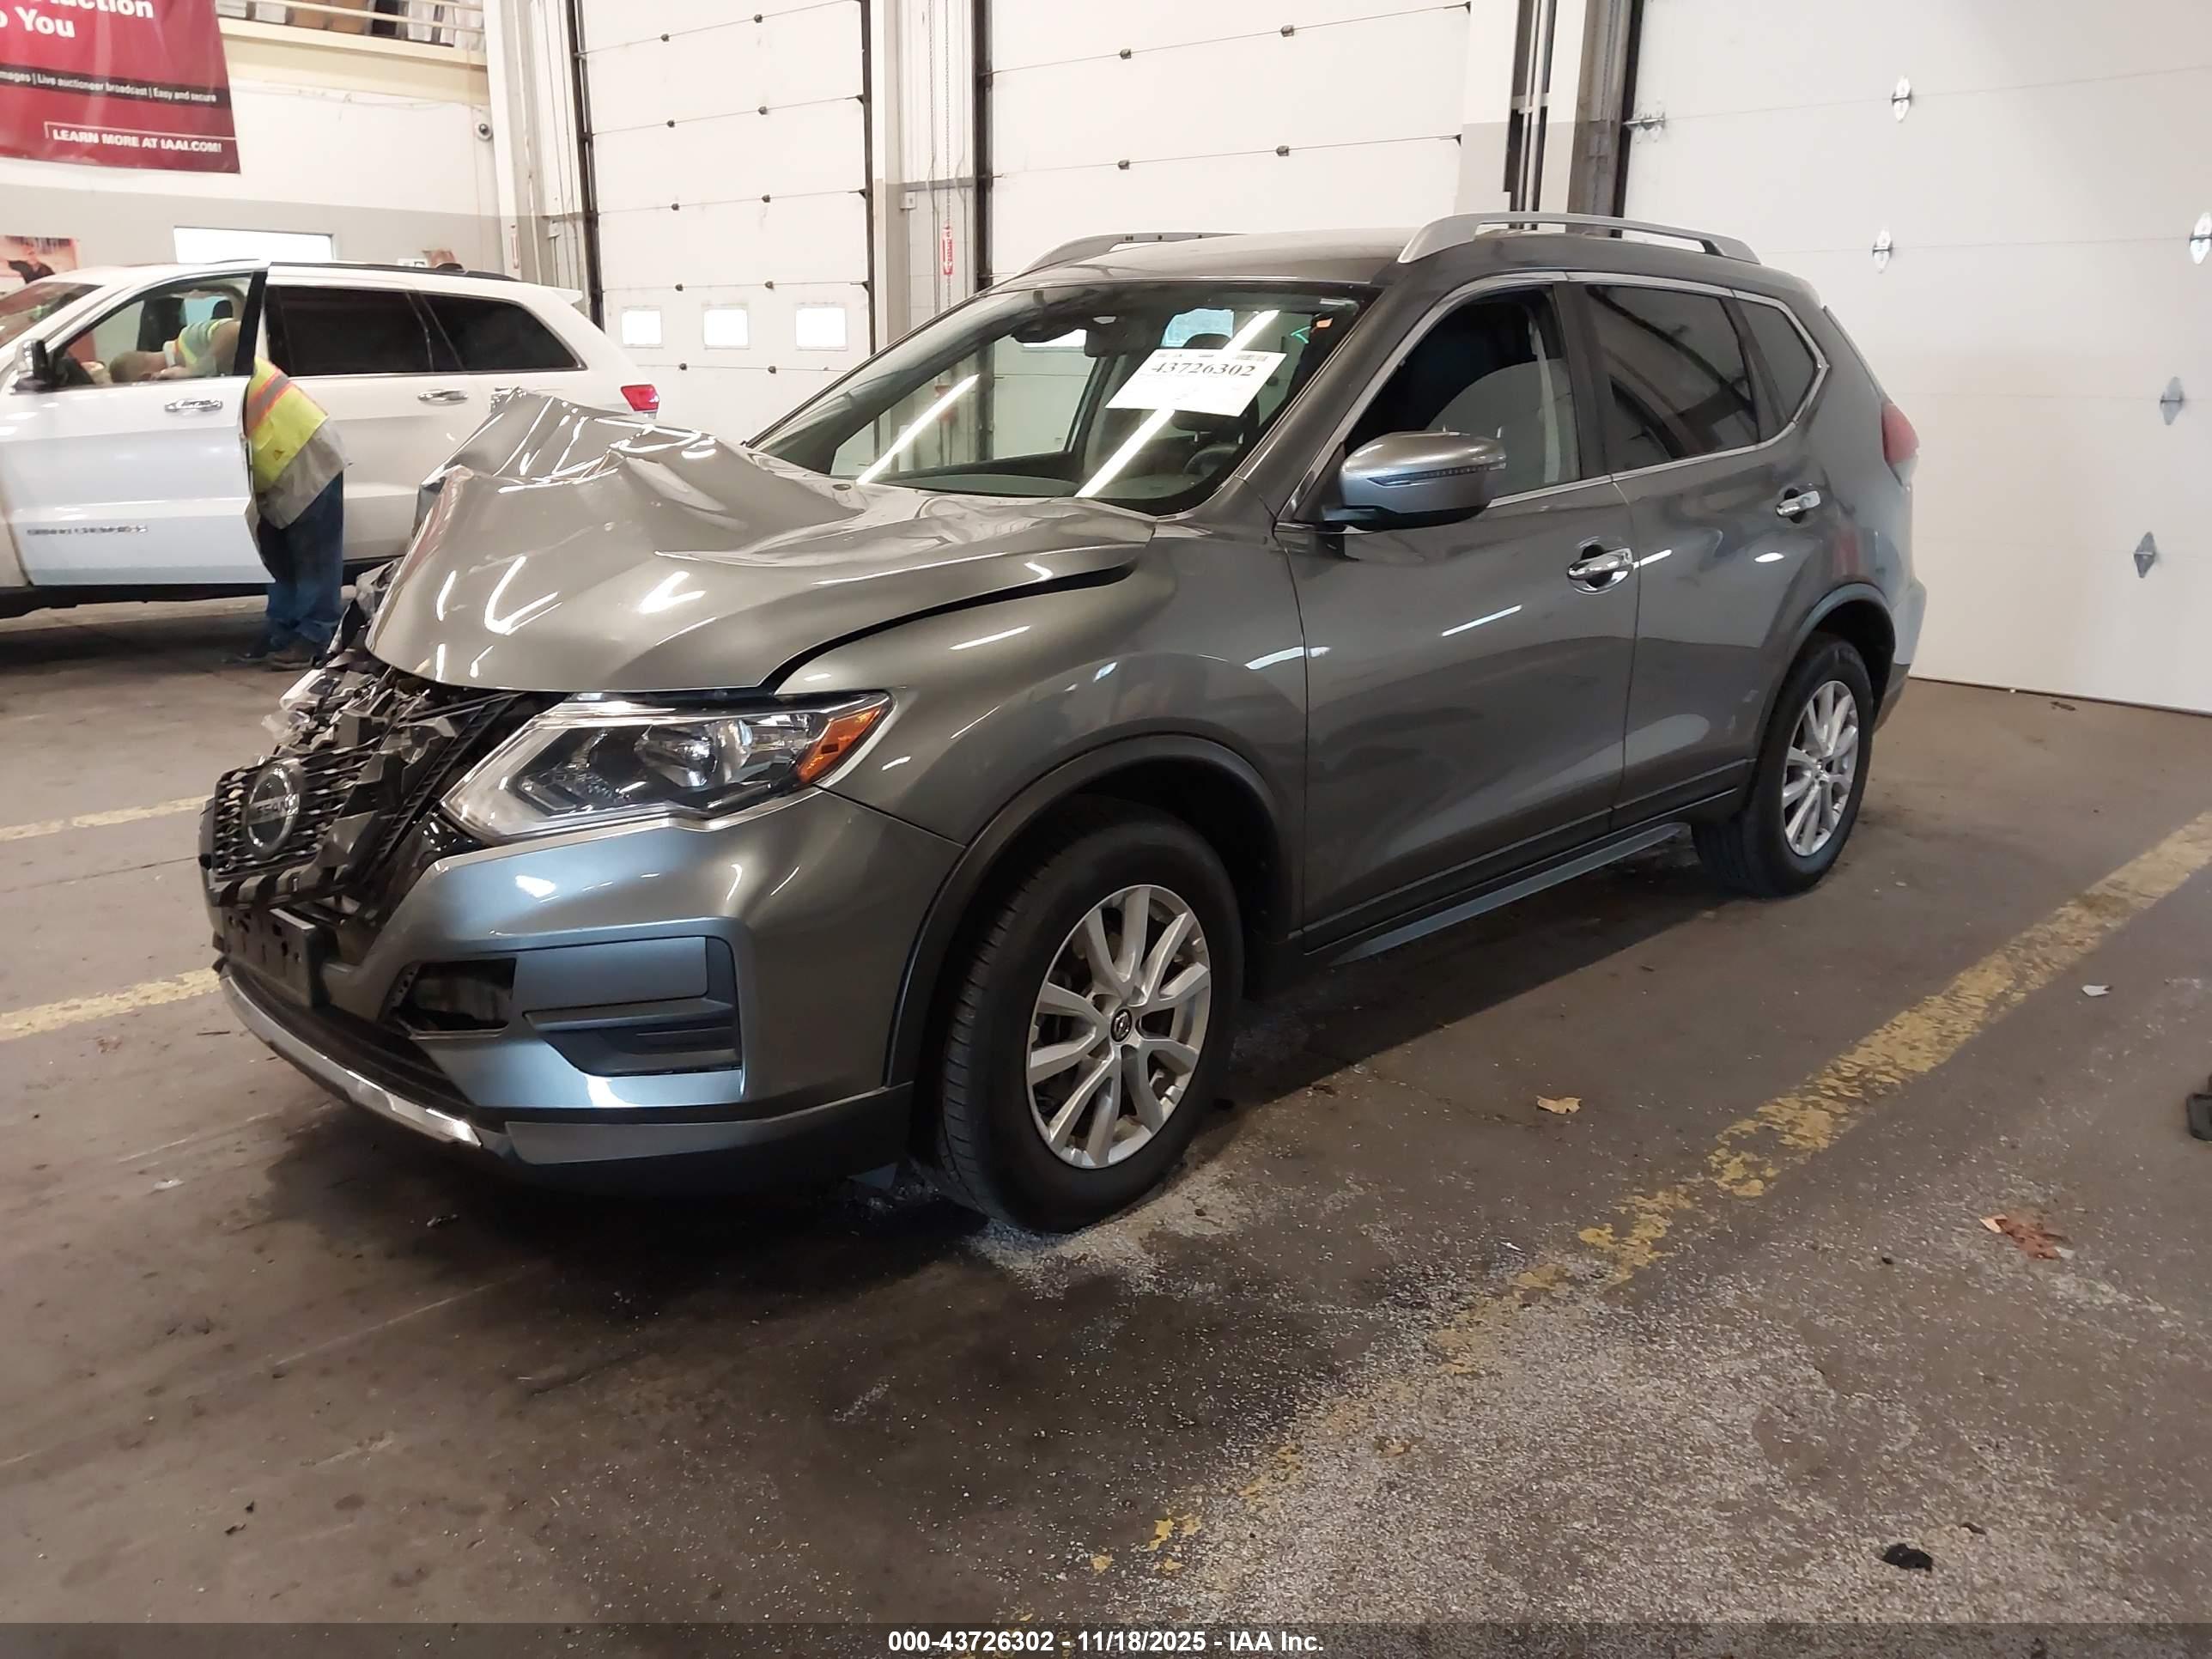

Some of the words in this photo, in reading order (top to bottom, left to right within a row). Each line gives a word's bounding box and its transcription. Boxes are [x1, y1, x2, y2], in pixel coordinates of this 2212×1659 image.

[34, 0, 154, 18] ction
[14, 6, 76, 38] You
[37, 73, 56, 86] Live
[58, 77, 104, 91] auctioneer
[106, 82, 148, 96] broadcast
[153, 87, 173, 100] Easy
[173, 90, 190, 100] and
[191, 92, 216, 102] secure
[52, 129, 100, 144] LEARN
[101, 133, 140, 148] MORE
[142, 137, 158, 149] AT
[161, 138, 222, 153] IAAI.COM!
[1152, 362, 1256, 376] 43726302
